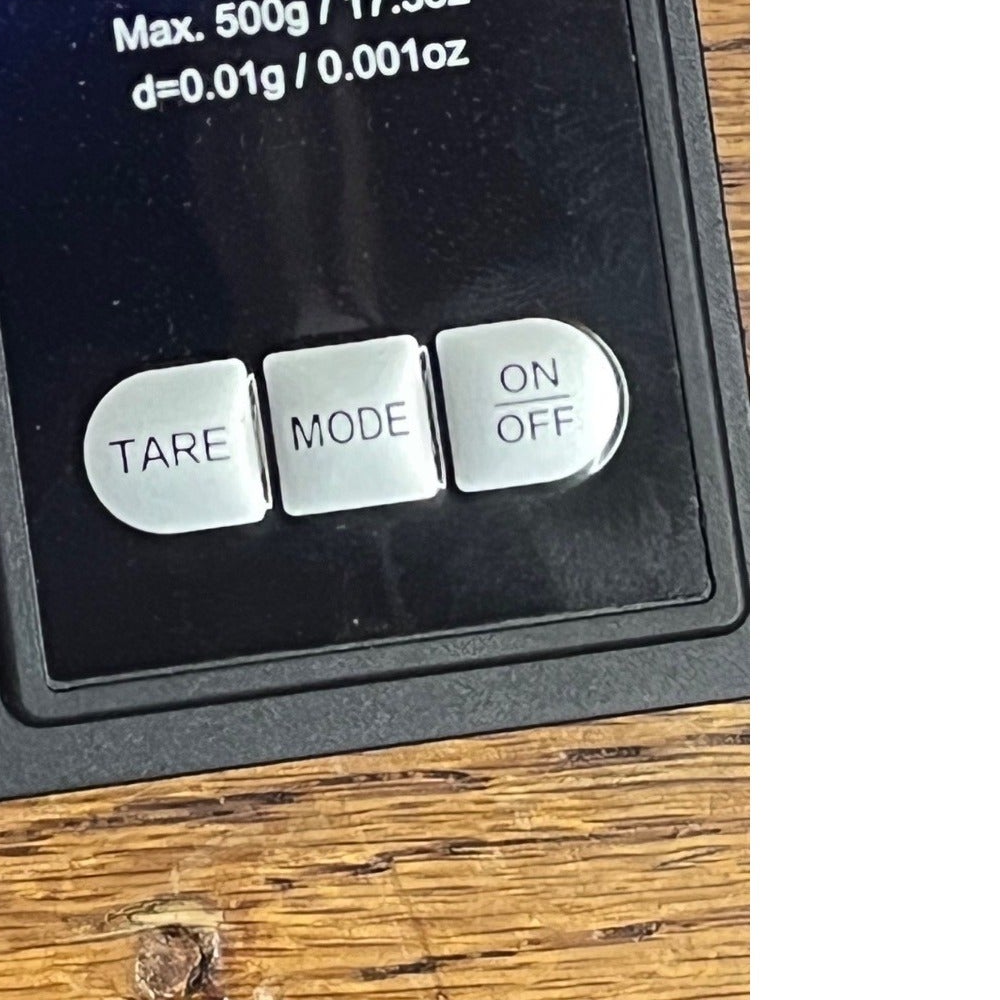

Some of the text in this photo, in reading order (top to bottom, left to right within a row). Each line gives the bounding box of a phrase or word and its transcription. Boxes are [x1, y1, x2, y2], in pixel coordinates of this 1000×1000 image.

[113, 13, 204, 52] Max.
[131, 60, 286, 111] d=0.01g
[317, 37, 470, 85] 0.001oz
[500, 358, 559, 394] ON
[292, 402, 411, 451] MODE
[496, 406, 575, 444] OFF
[109, 427, 231, 474] TARE
